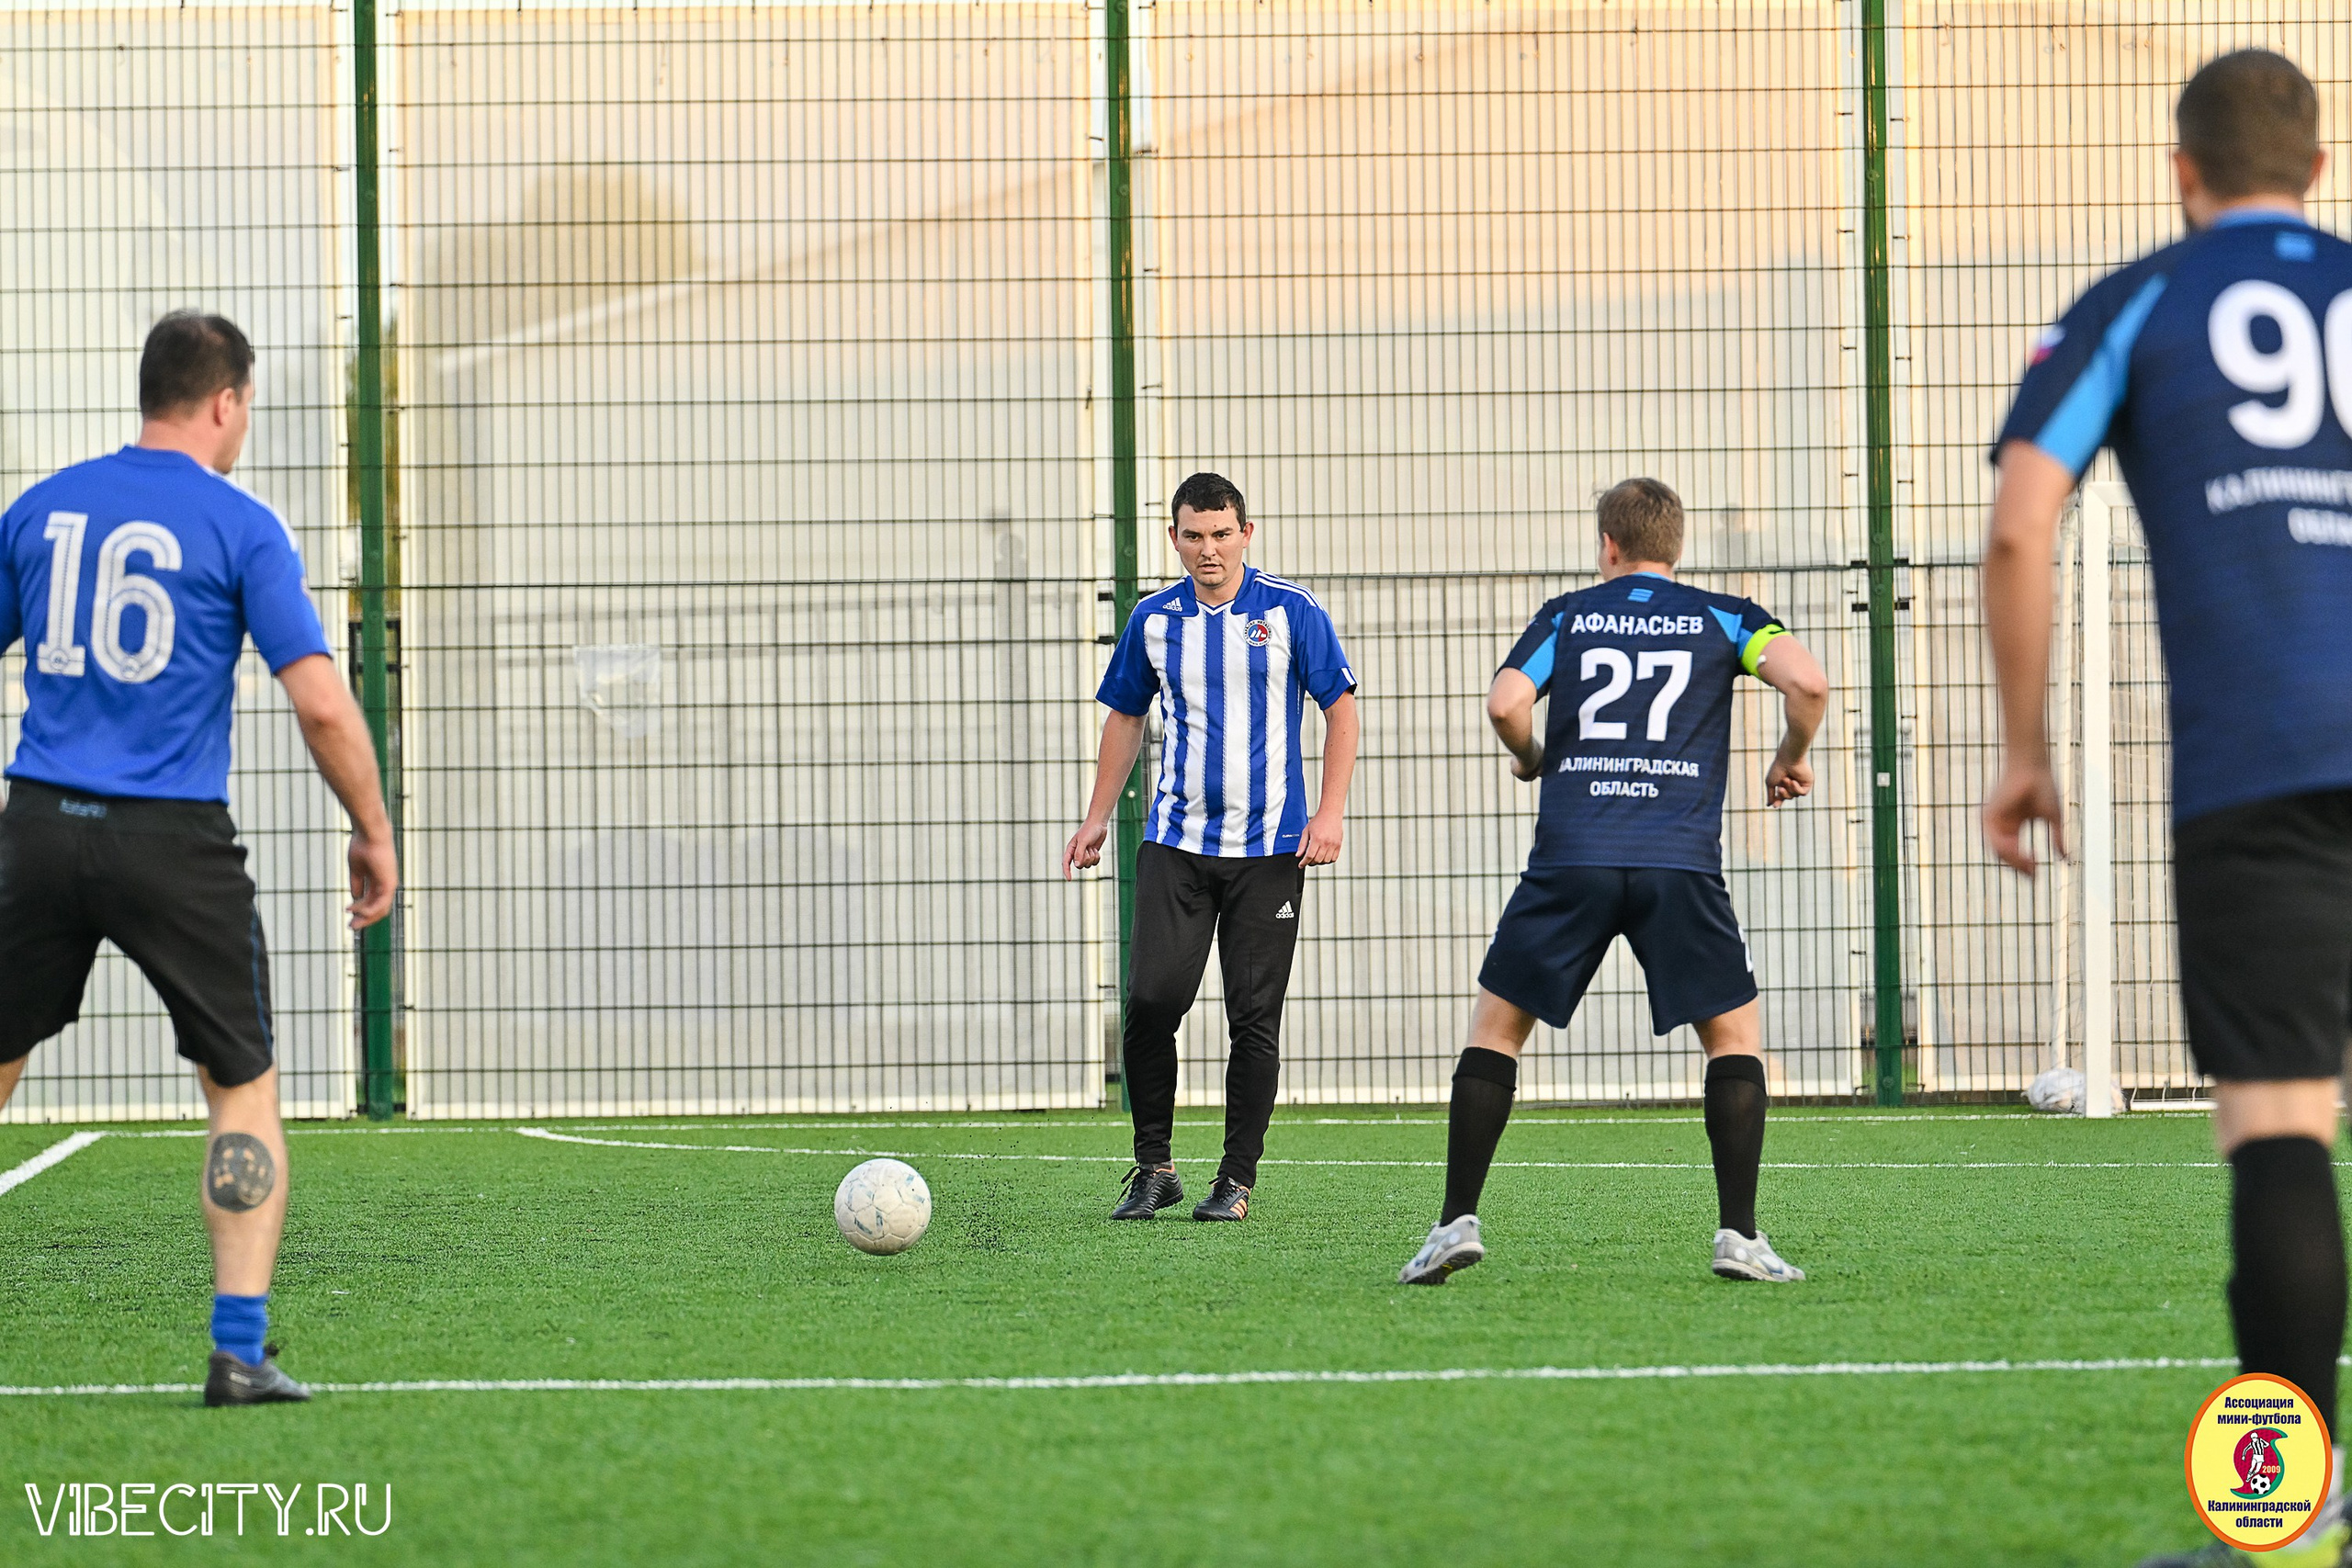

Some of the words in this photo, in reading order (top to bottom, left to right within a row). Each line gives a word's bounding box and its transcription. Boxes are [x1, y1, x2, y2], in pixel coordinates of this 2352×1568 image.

[2208, 279, 2352, 449] 9
[37, 511, 183, 684] 16
[1570, 612, 1703, 636] АФАНАСЬЕВ
[1578, 647, 1693, 741] 27
[1589, 781, 1659, 798] ОБЛАСТЬ
